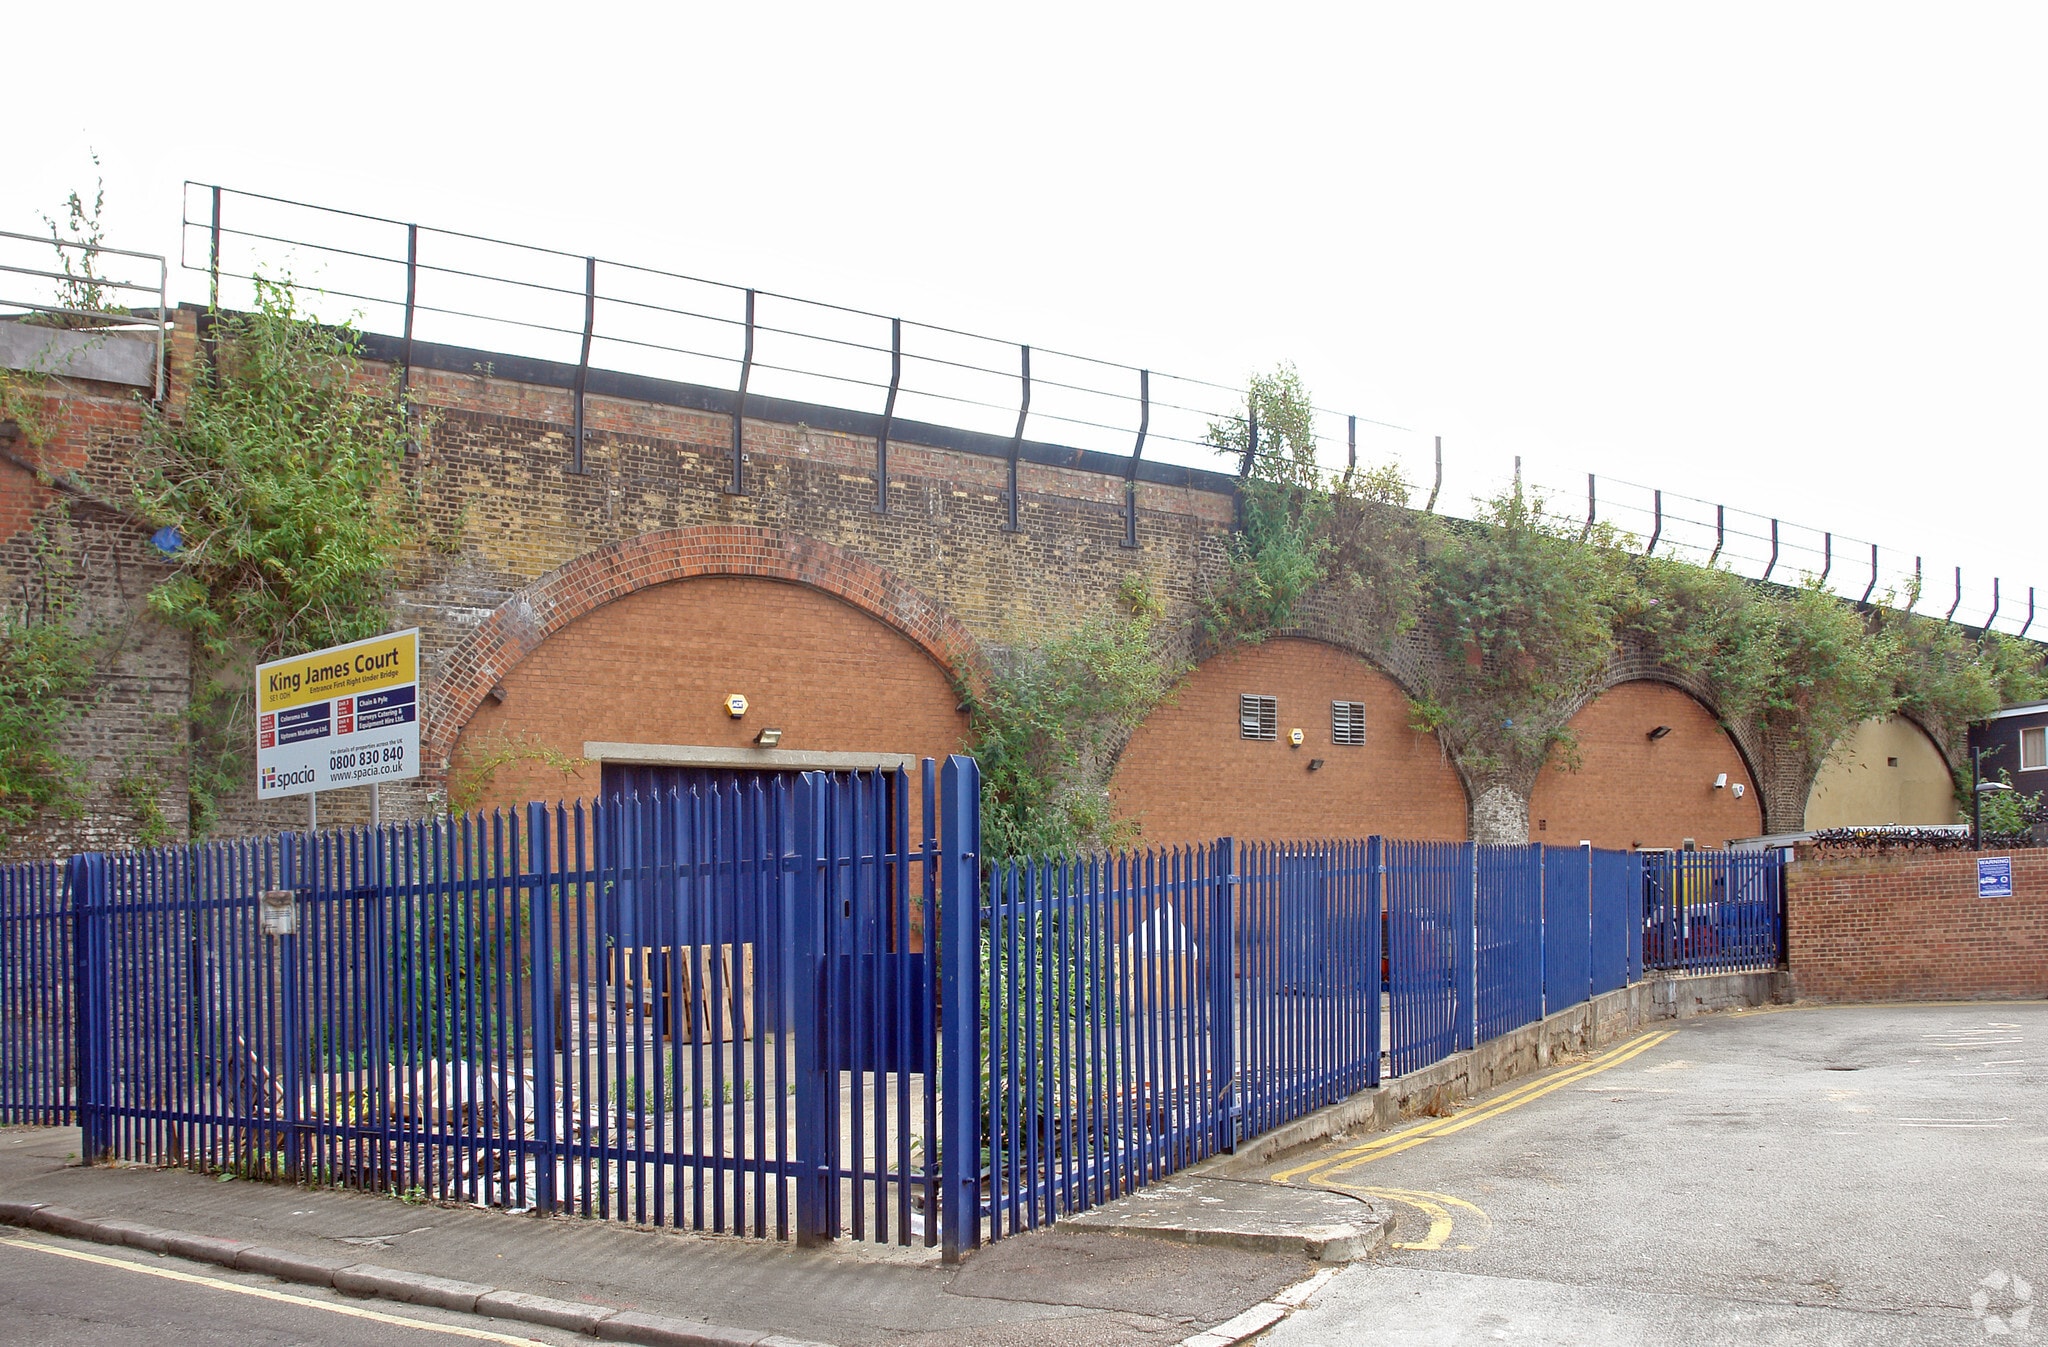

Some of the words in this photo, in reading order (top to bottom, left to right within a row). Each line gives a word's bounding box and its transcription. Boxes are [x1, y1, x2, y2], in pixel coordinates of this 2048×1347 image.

[270, 672, 300, 692] King
[305, 662, 350, 684] James
[355, 647, 398, 673] Court
[310, 684, 332, 694] Entrance
[346, 677, 361, 686] Right
[362, 674, 379, 682] Under
[380, 669, 398, 678] Bridge
[359, 698, 372, 706] Chain
[378, 696, 388, 704] Pyle
[378, 709, 397, 718] Catering
[298, 727, 319, 736] Marketing
[359, 720, 384, 729] Equipment
[330, 754, 356, 770] 0800
[360, 750, 379, 766] 830
[383, 746, 403, 762] 840
[277, 765, 315, 790] spacia
[330, 761, 403, 781] www.spacia.co.uk
